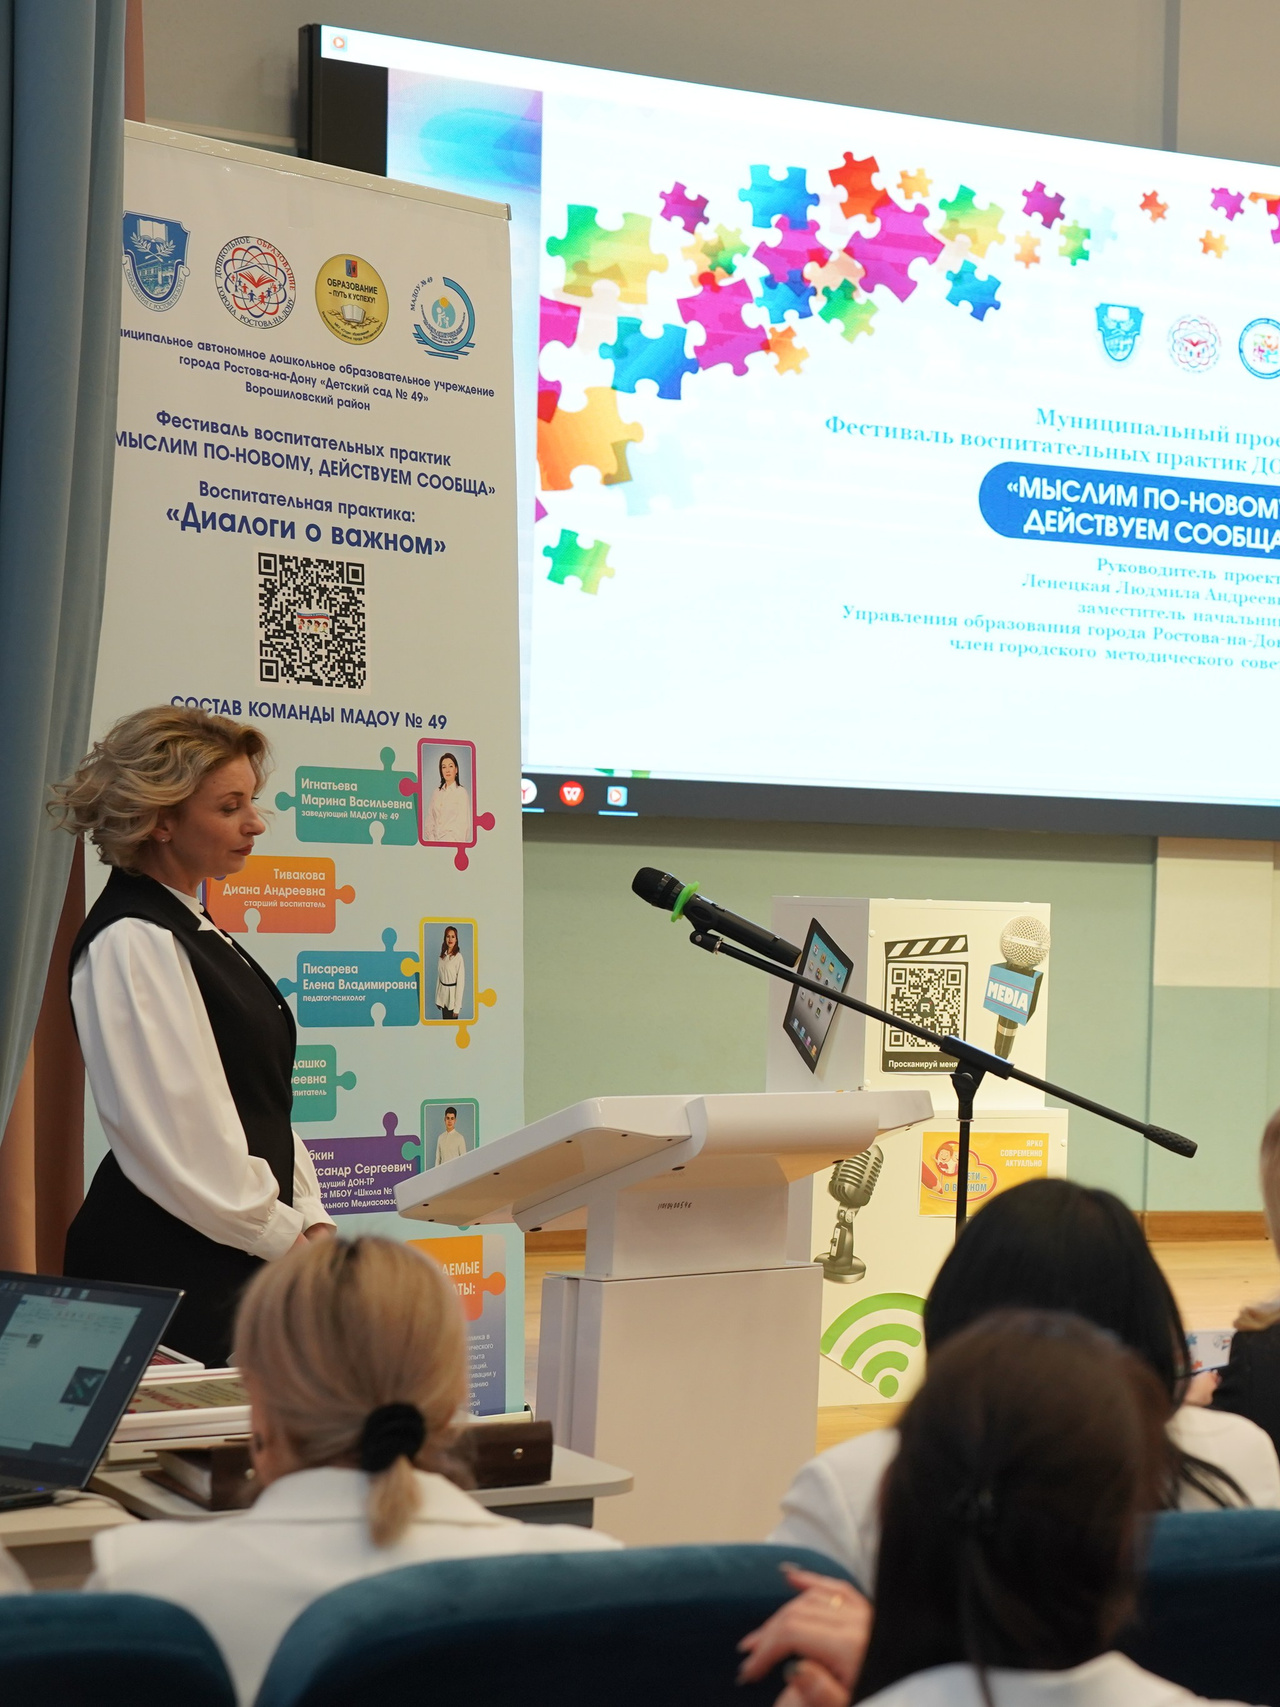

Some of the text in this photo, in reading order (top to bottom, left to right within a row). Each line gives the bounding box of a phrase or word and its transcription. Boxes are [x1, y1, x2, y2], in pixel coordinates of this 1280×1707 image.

[215, 237, 296, 291] ДОШКОЛЬНОЕ ОБРАЗОВАНИЕ
[326, 278, 378, 295] ОБРАЗОВАНИЕ
[332, 290, 348, 299] ПУТЬ
[216, 286, 237, 316] ГОРОДА
[197, 341, 266, 360] автономное
[269, 353, 336, 372] дошкольное
[339, 364, 431, 387] образовательное
[434, 379, 495, 397] учреждение
[179, 355, 429, 402] города Ростова-на-Дону «Детский сад № 49»
[245, 381, 371, 411] Ворошиловский район
[1036, 407, 1230, 443] Муниципальный
[156, 410, 452, 466] Фестиваль воспитательных практик
[825, 415, 954, 445] Фестиваль
[960, 433, 1150, 463] воспитательных
[1156, 451, 1247, 472] практик
[115, 430, 496, 497] МЫСЛИМ ПО-НОВОМУ, ДЕЙСТВУЕМ СООБЩА»
[1006, 476, 1138, 508] «МЫСЛИМ
[199, 480, 416, 523] Воспитательная практика:
[166, 502, 447, 555] «Диалоги о важном»
[1022, 506, 1169, 542] ДЕЙСТВУЕМ
[1097, 557, 1217, 580] Руководитель
[1021, 573, 1111, 594] Ленецкая
[1115, 581, 1200, 600] Людмила
[1077, 603, 1186, 621] заместитель
[842, 604, 958, 626] Управления
[963, 614, 1081, 635] образования
[1088, 625, 1146, 641] города
[949, 638, 994, 652] член
[999, 642, 1097, 659] городского
[1104, 649, 1234, 668] методического
[170, 695, 447, 729] СОСТАВ КОМАНДЫ МАДОУ № 49
[301, 777, 358, 791] Игнатьева
[301, 794, 413, 810] Марина Васильевна
[301, 810, 400, 820] заведующий МАДОУ № 49
[273, 868, 326, 881] Тивакова
[222, 883, 326, 898] Диана Андреевна
[243, 900, 326, 908] старший воспитатель
[302, 963, 359, 976] Писарева
[302, 978, 417, 993] Елена Владимировна
[302, 994, 366, 1003] педагог-психолог
[986, 980, 1029, 1012] MEDIA
[888, 1060, 938, 1069] Просканируй
[1000, 1149, 1043, 1157] СОВРЕМЕННО
[354, 1163, 412, 1176] Сергеевич
[967, 1172, 981, 1180] ЕТИ
[347, 1177, 375, 1188] ДОН-ТР
[952, 1183, 987, 1191] ВНОМ
[329, 1189, 352, 1198] МБОУ
[383, 1187, 393, 1195] №
[440, 1261, 480, 1276] АЕМЫЕ
